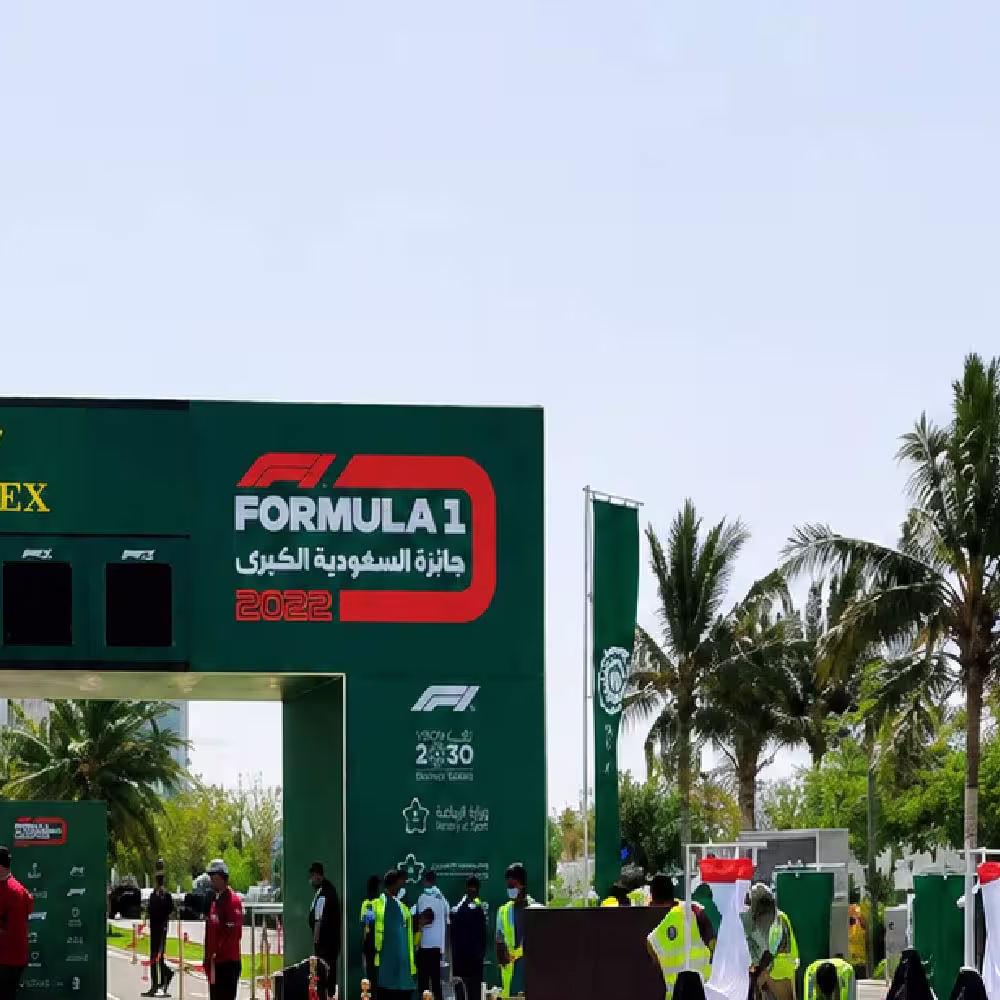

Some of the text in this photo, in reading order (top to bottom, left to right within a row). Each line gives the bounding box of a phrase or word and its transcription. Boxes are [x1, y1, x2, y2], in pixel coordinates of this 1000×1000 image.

[235, 495, 466, 534] FORMULA 1
[235, 547, 466, 579] جائزة السعودية الكبرى
[235, 589, 333, 621] 2022
